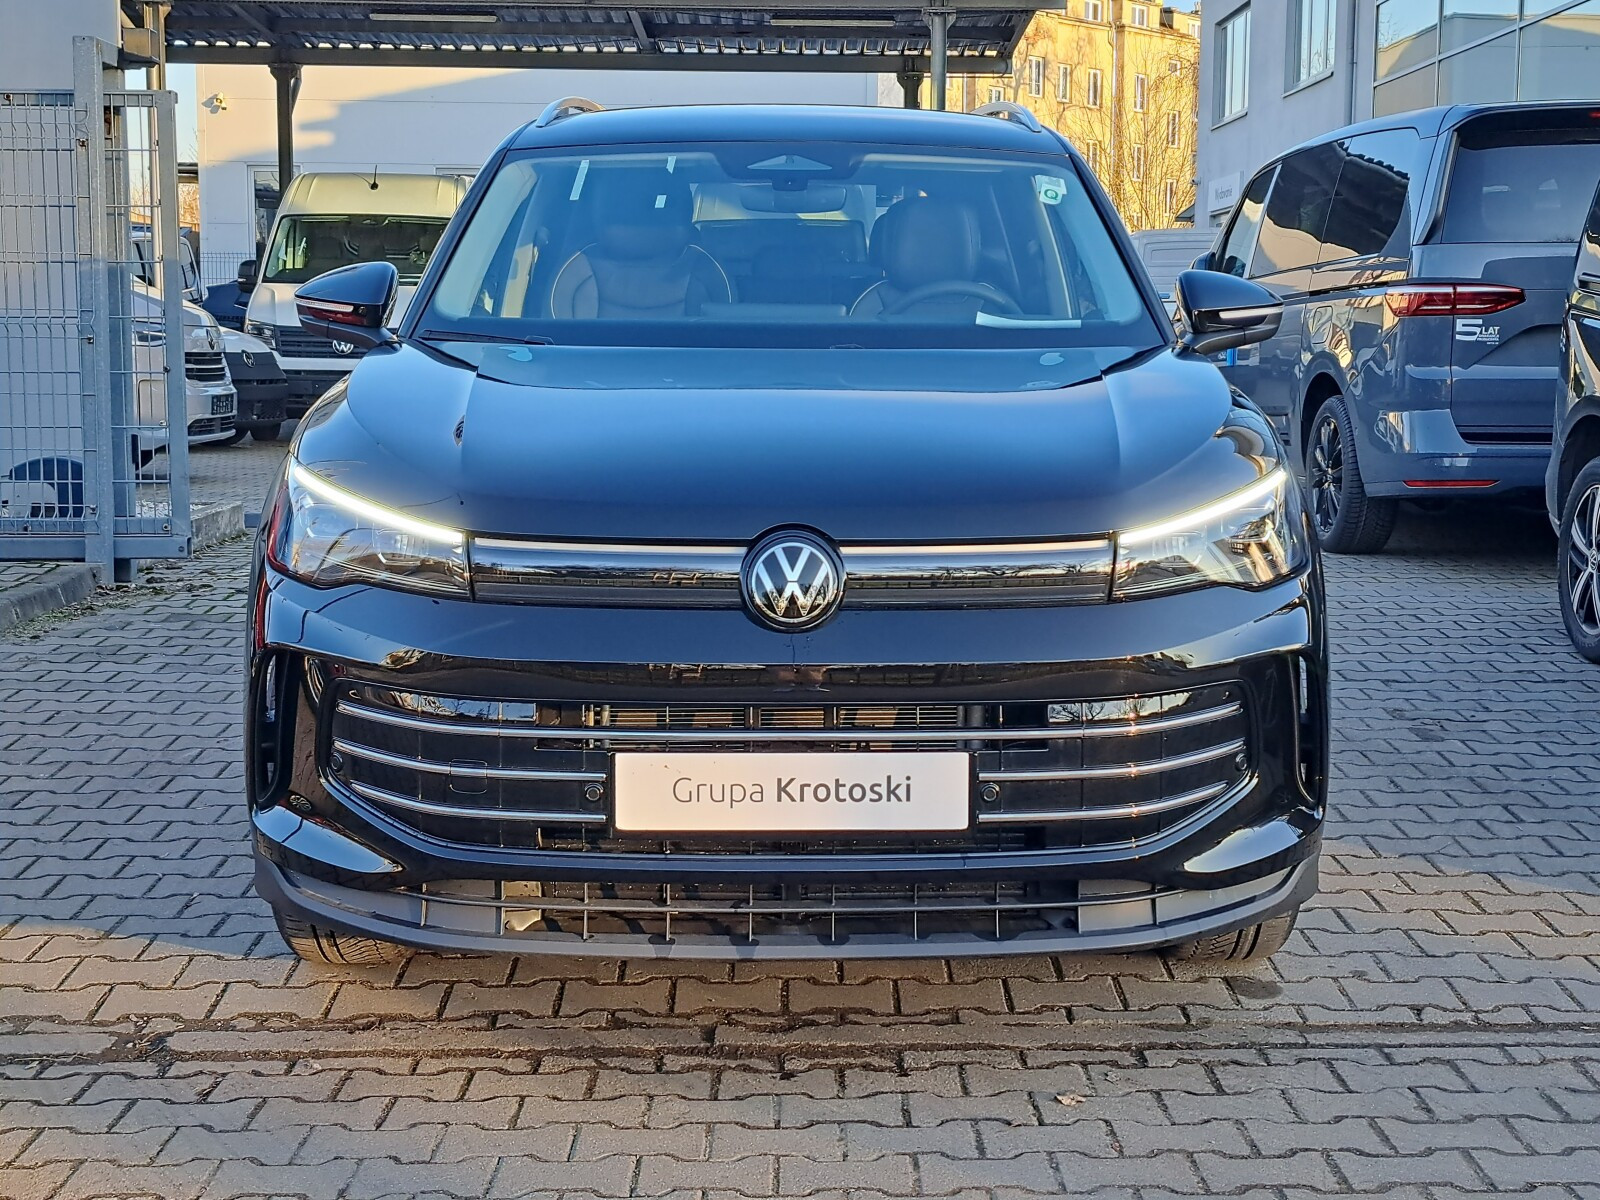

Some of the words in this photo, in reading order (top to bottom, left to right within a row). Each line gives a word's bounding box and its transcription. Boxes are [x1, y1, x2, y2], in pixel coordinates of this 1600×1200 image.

[1043, 188, 1059, 201] Q
[1455, 318, 1483, 341] 5
[1482, 326, 1500, 335] LAT
[672, 777, 764, 809] Grupa
[776, 774, 912, 803] Krotoski
